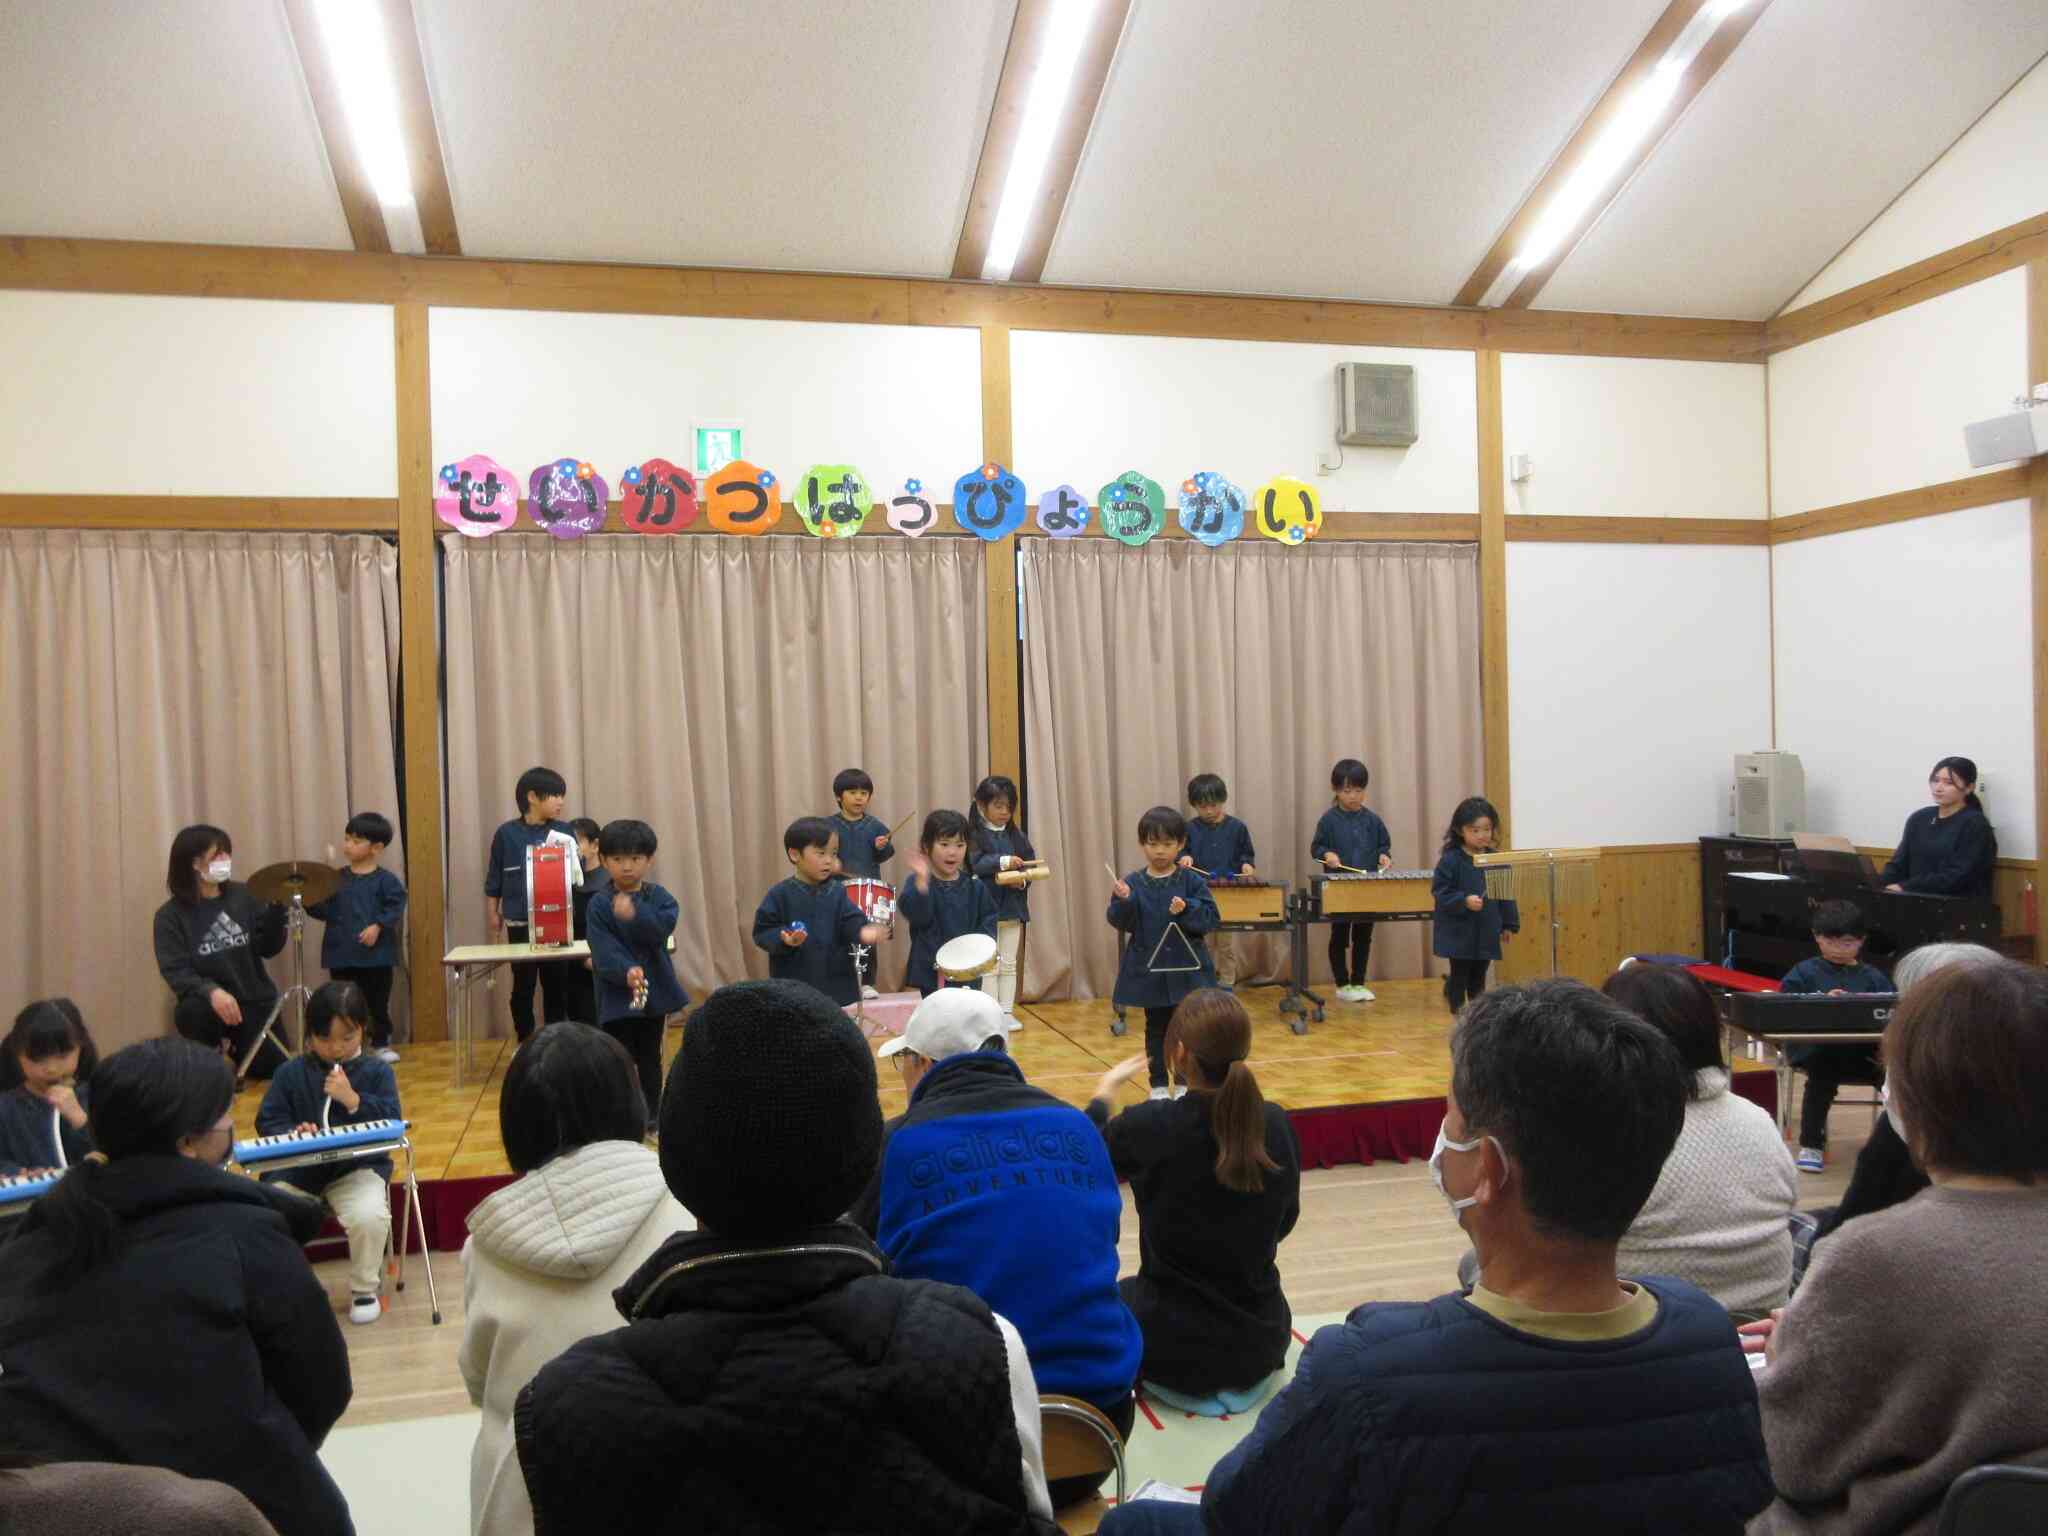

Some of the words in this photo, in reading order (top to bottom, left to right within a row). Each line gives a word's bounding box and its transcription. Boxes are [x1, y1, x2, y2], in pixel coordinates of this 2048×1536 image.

[448, 470, 1315, 536] せいかつはっぴょうかい
[909, 1128, 1089, 1187] adidas
[922, 1167, 1097, 1215] ADVENTURE
